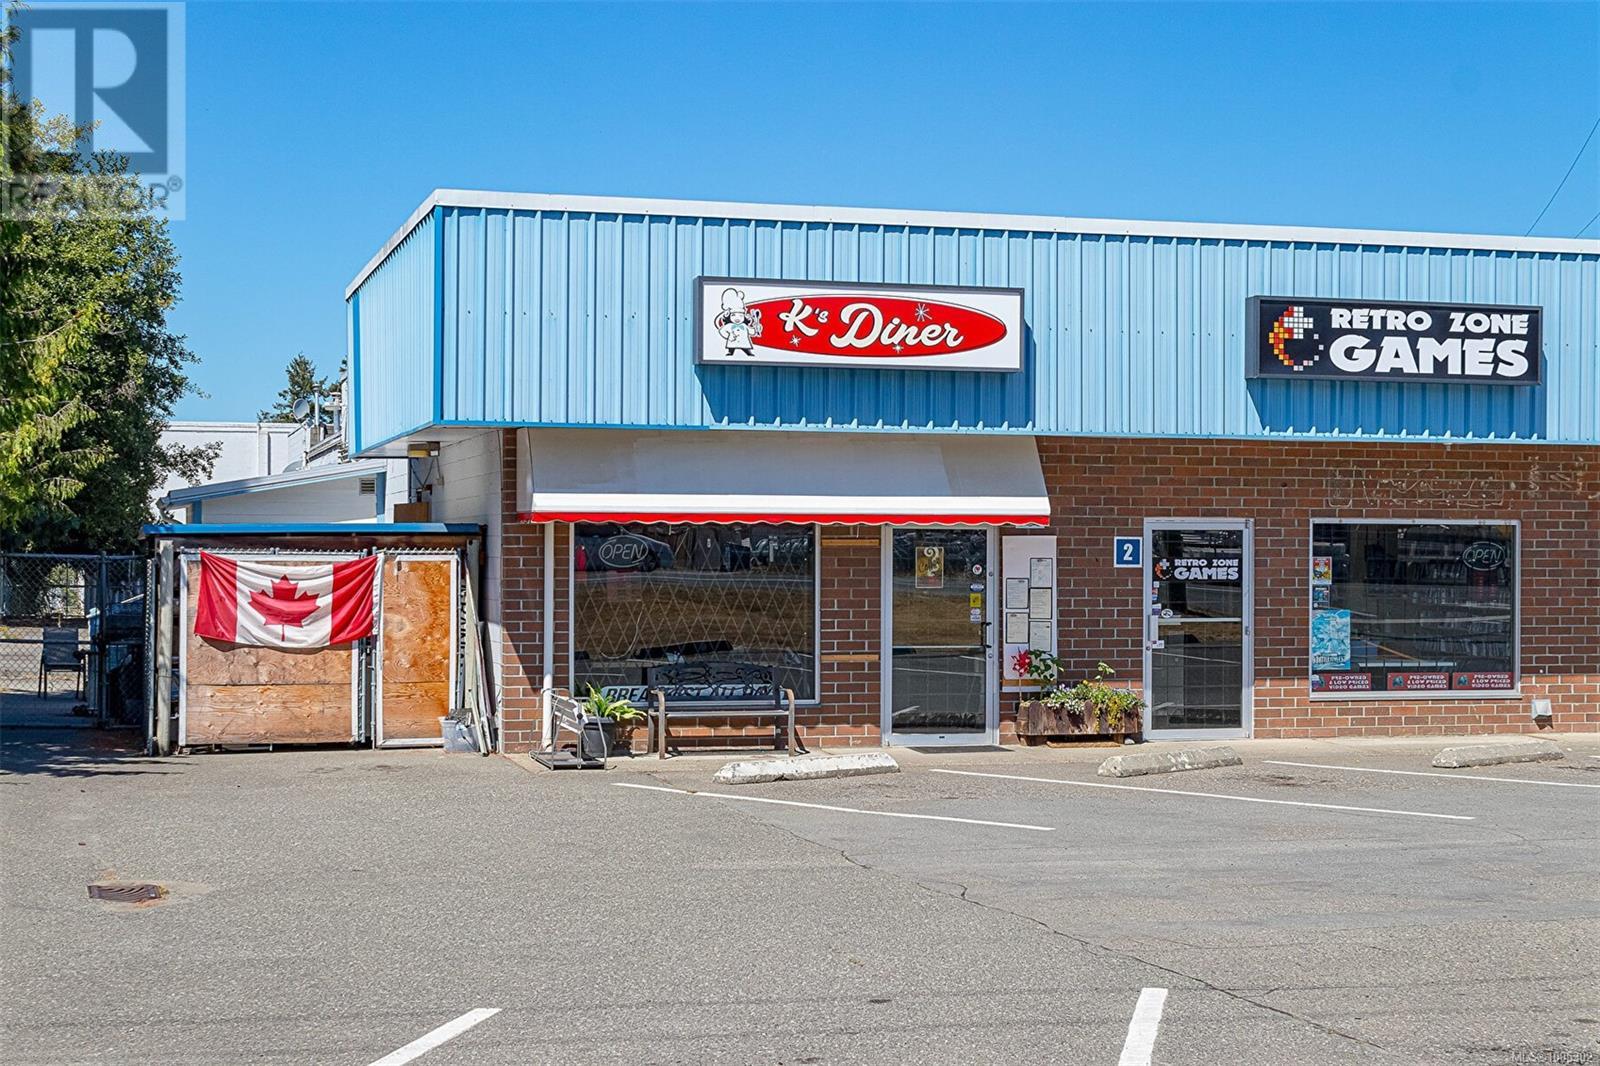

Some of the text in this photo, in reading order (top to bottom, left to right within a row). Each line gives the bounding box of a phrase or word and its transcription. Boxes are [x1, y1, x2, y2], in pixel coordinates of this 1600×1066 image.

[779, 298, 964, 349] K's Diner
[1330, 308, 1530, 335] RETRO ZONE
[1329, 334, 1529, 378] GAMES
[601, 543, 645, 560] OPEN
[1123, 543, 1134, 561] 2
[1466, 548, 1502, 563] OPEN
[1174, 558, 1239, 567] RETRO ZONE
[1174, 567, 1239, 580] GAMES
